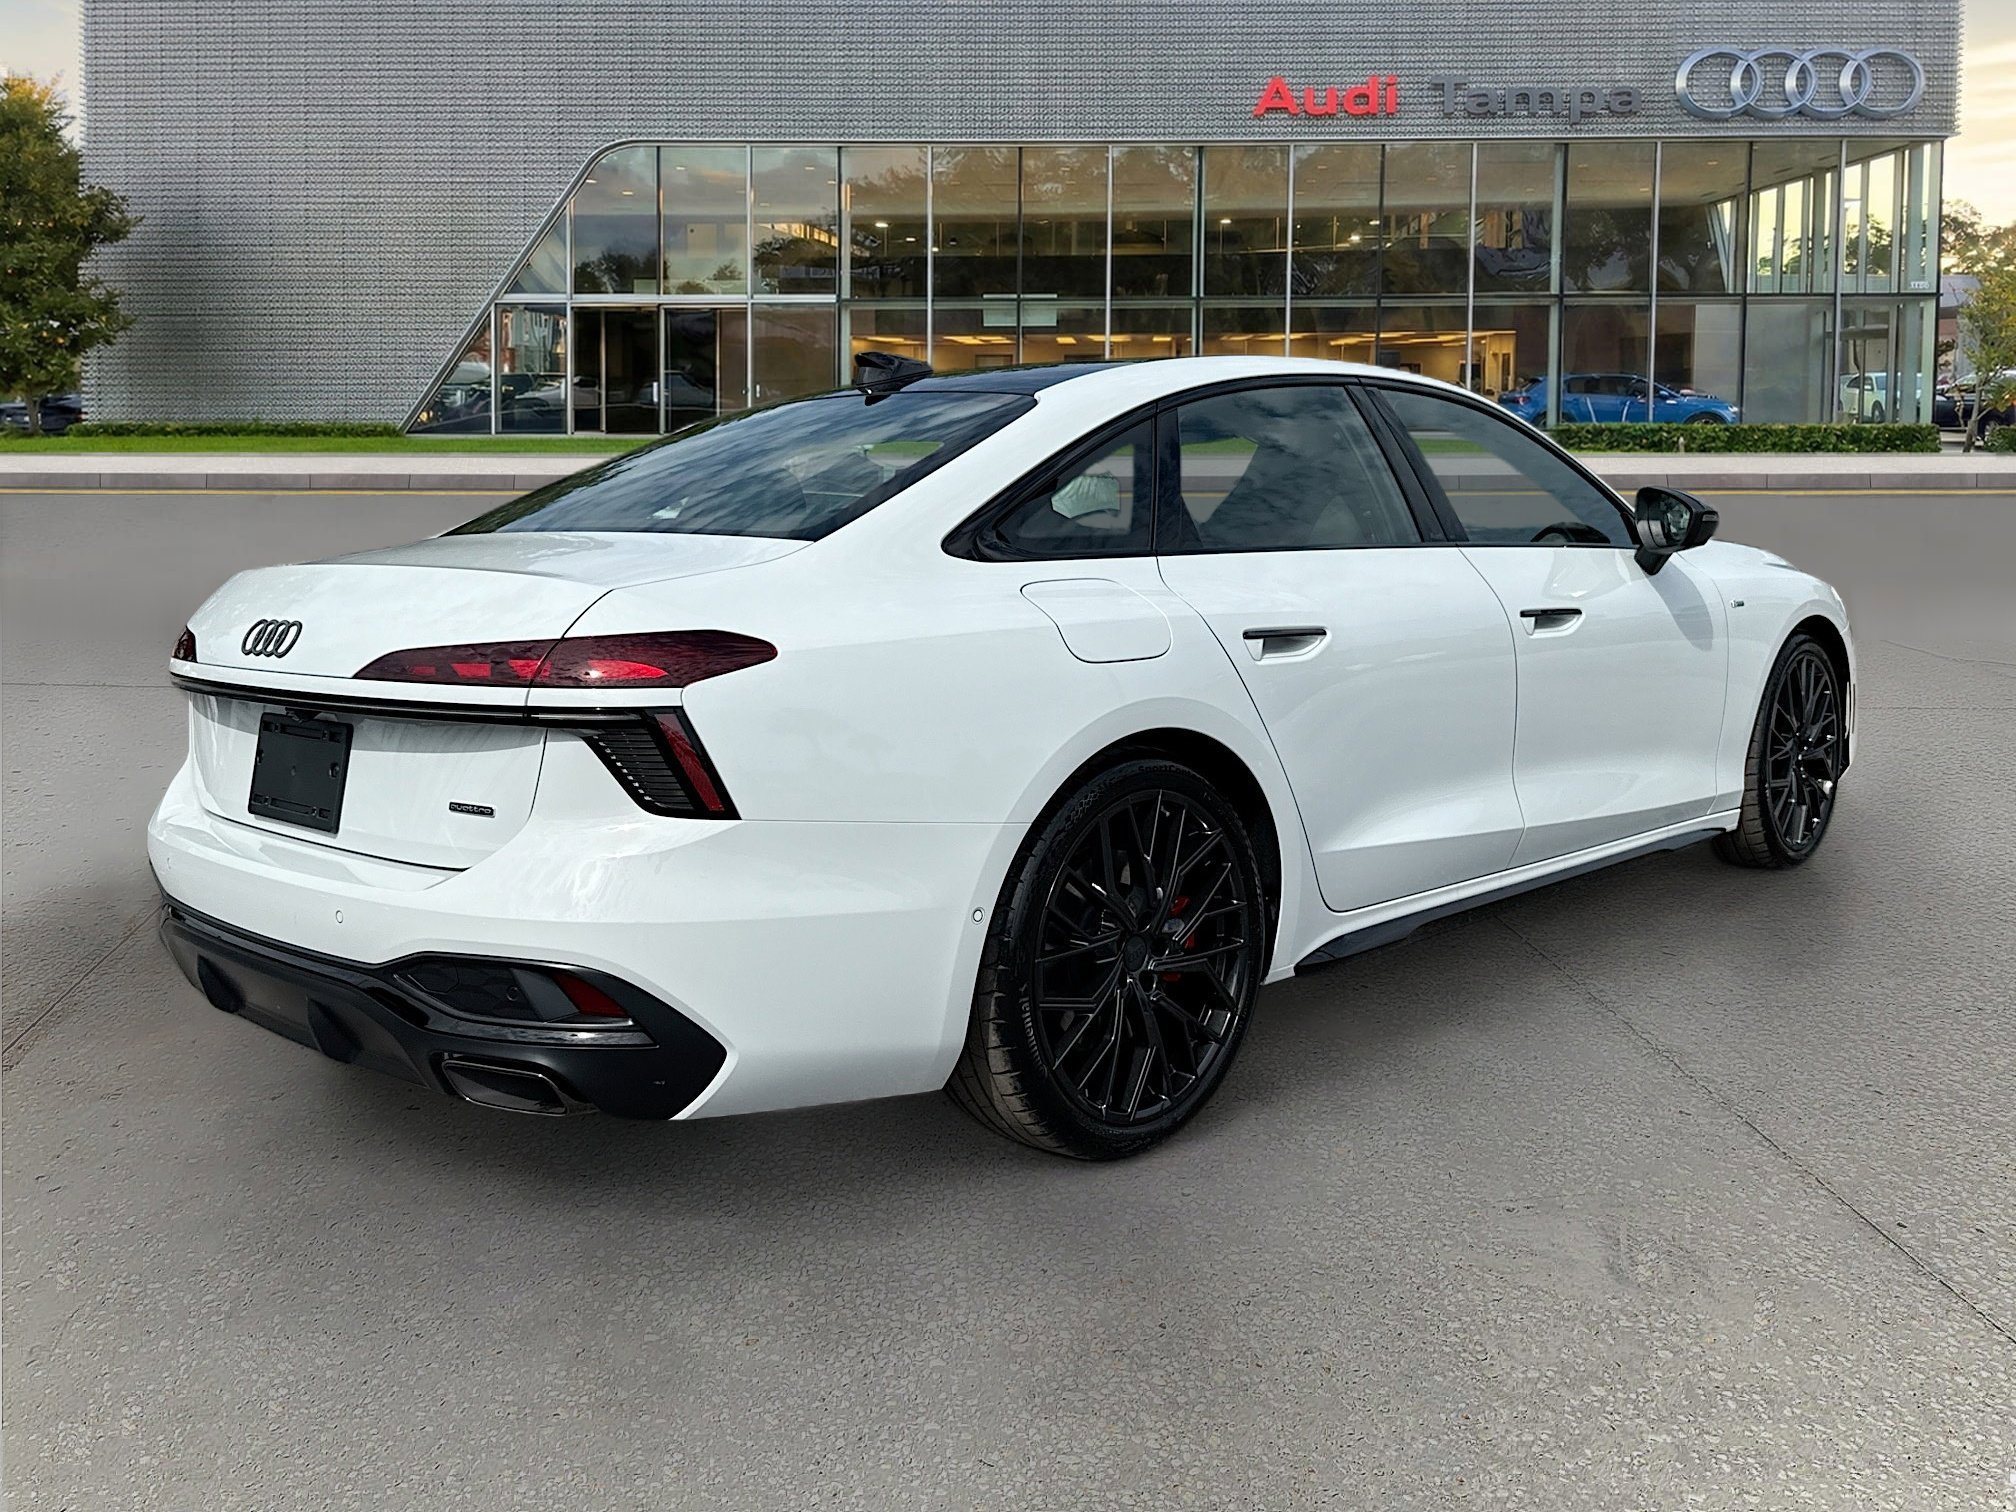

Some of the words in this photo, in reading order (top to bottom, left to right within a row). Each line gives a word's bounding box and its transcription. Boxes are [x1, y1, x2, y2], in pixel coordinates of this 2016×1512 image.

[1253, 75, 1398, 116] Audi
[1431, 75, 1642, 125] Tampa
[450, 803, 492, 814] quattro
